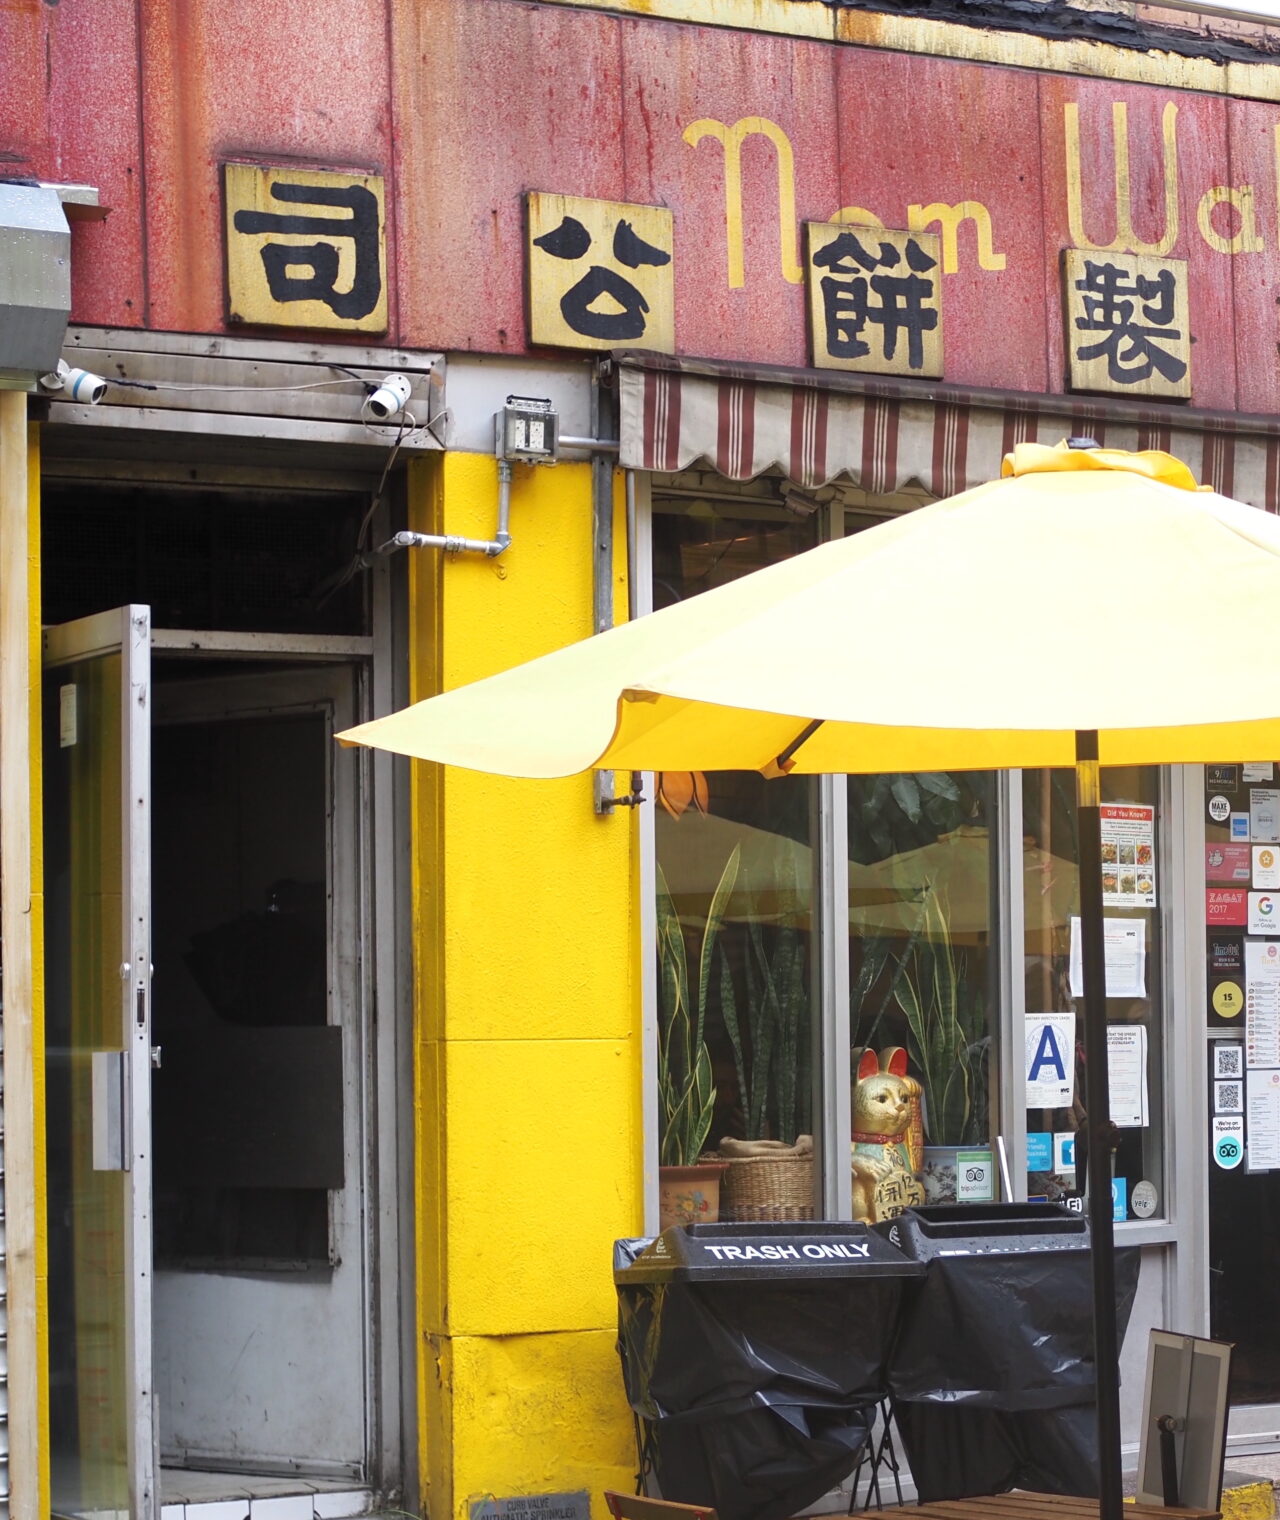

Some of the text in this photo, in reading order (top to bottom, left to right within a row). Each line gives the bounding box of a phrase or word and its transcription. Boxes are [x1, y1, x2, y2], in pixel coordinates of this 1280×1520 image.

[682, 116, 1006, 290] Nm
[235, 181, 382, 319] 司
[533, 215, 672, 341] 公
[1209, 893, 1243, 903] ZAGAT
[1209, 904, 1228, 914] 2017
[1223, 993, 1233, 1001] 15
[1028, 1025, 1067, 1081] A
[704, 1243, 869, 1260] TRASH ONLY
[527, 1498, 549, 1509] VALVE
[530, 1507, 576, 1520] SPRINKLER
